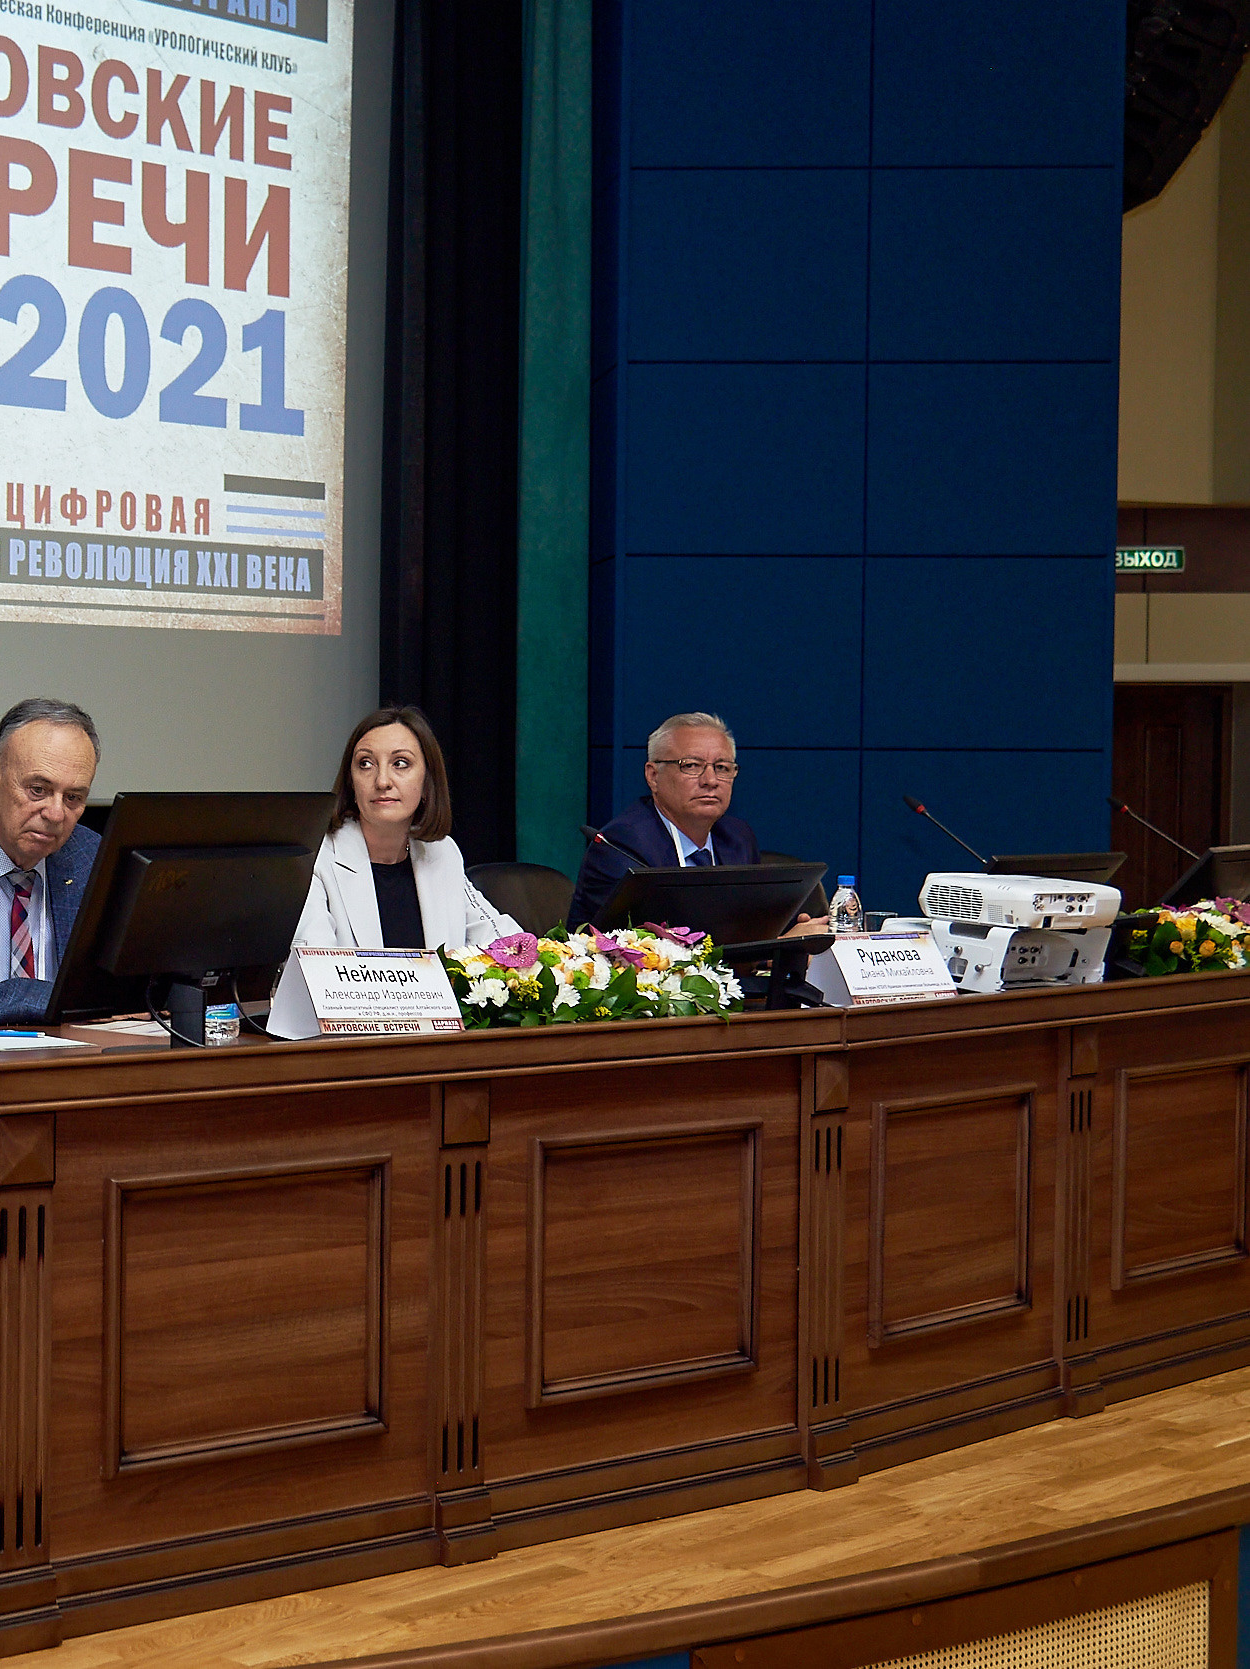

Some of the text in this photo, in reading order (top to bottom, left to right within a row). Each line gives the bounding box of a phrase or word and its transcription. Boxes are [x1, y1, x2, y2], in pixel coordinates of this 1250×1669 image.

[46, 4, 145, 43] Конференция
[5, 483, 211, 536] ЦИФРОВАЯ
[8, 538, 190, 588] РЕВОЛЮЦИЯ
[195, 552, 239, 588] XXI
[246, 555, 311, 592] ВЕКА
[857, 948, 922, 967] Рудакова
[335, 964, 419, 987] Неймарк
[324, 988, 444, 1002] Александр Израилевич
[323, 1024, 422, 1033] МАРТОВСКИЕ ВСТРЕЧИ
